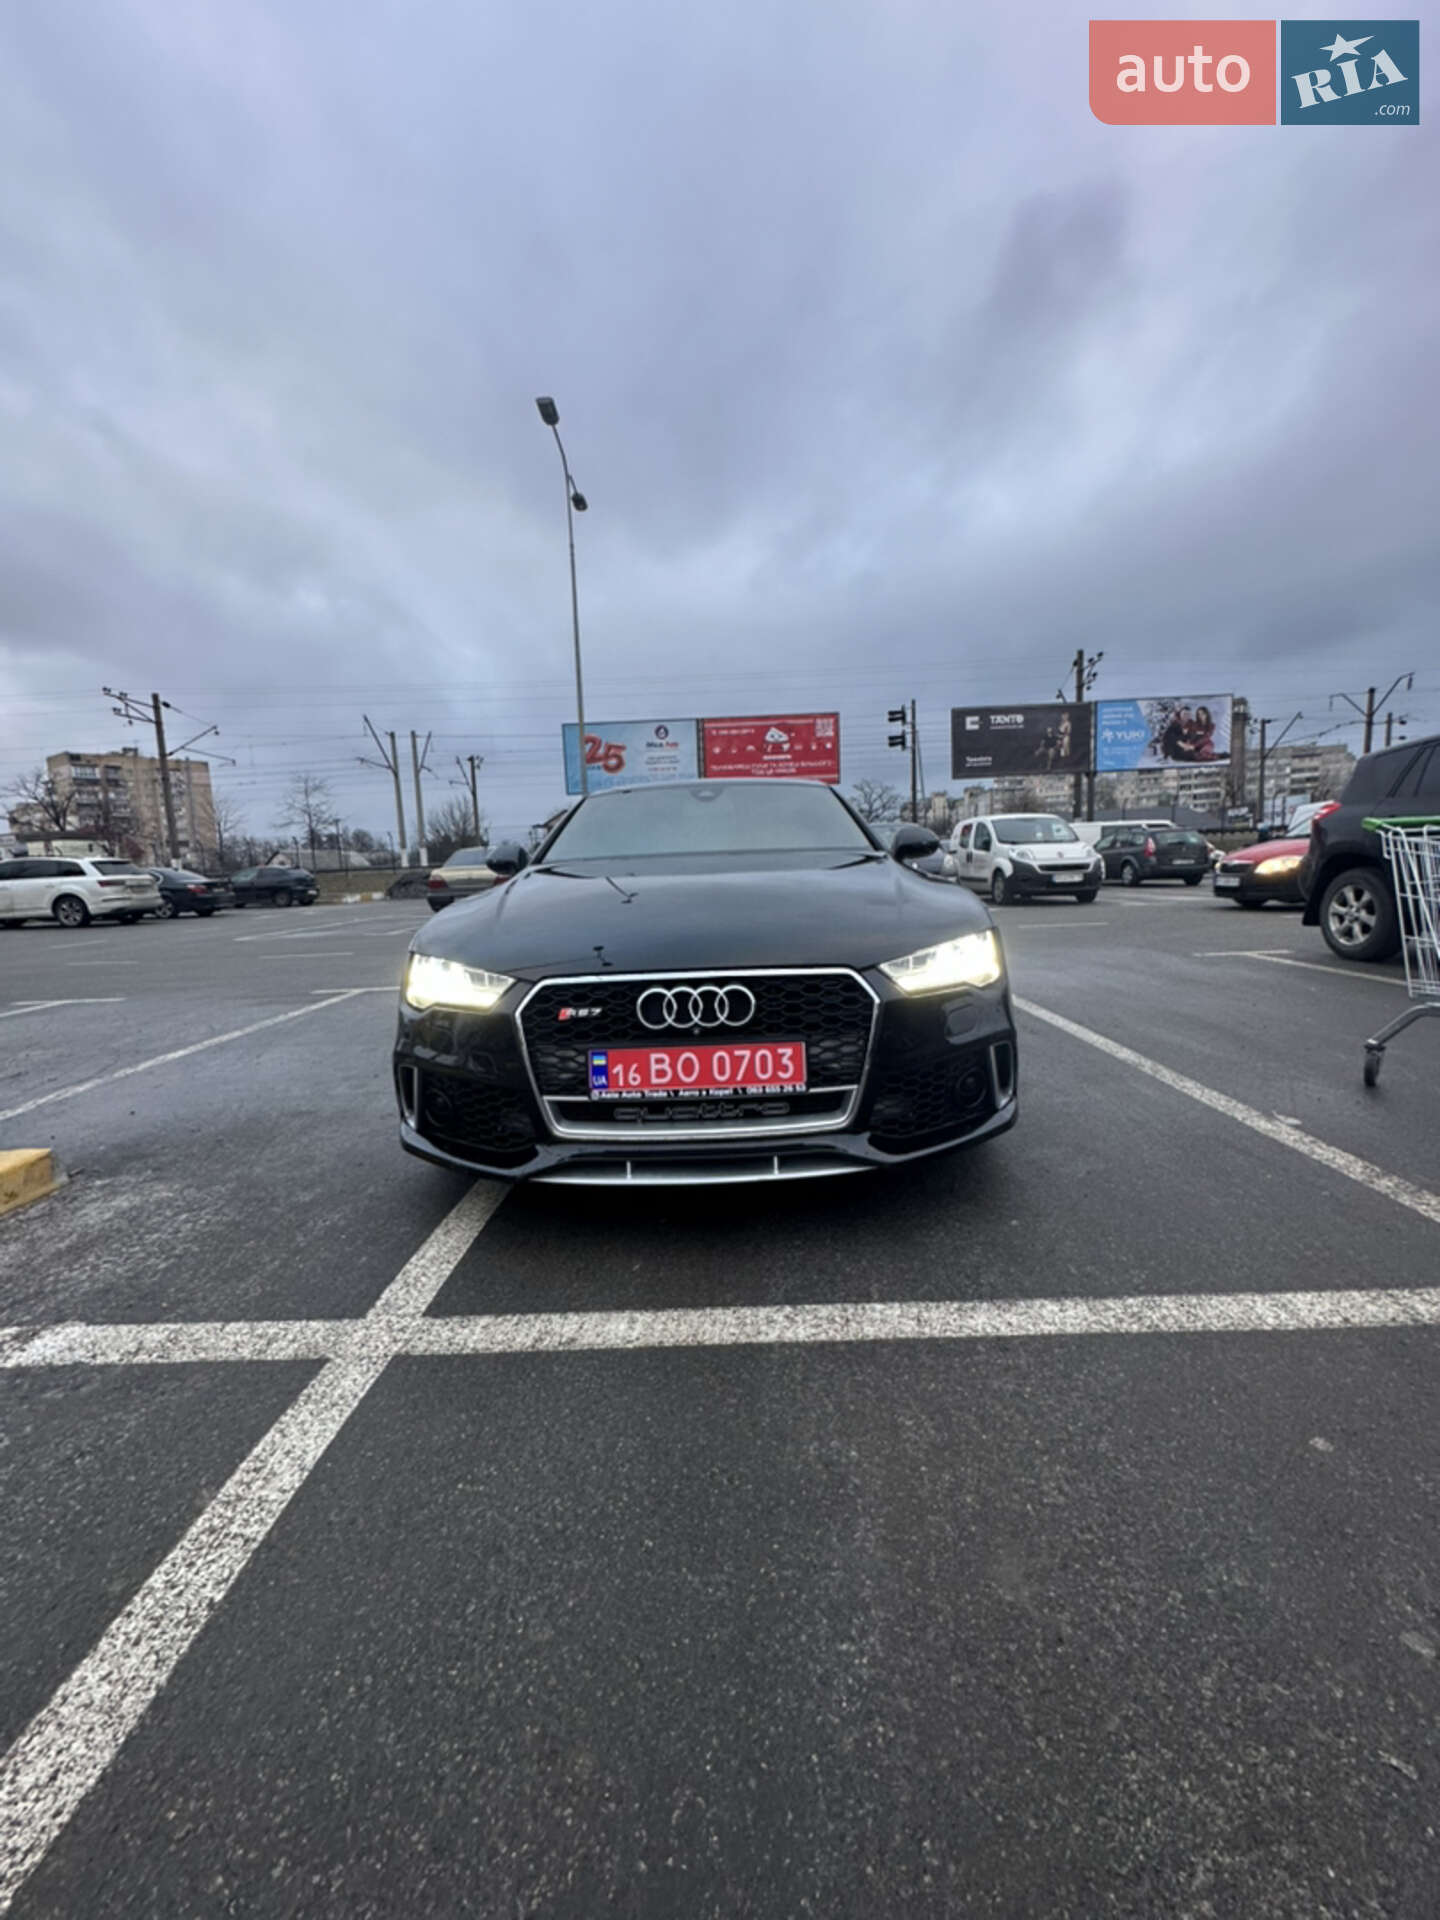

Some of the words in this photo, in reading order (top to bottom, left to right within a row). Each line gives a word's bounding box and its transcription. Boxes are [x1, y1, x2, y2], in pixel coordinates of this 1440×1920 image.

[584, 735, 627, 774] 25
[593, 1076, 607, 1087] UA
[612, 1064, 641, 1087] 16
[650, 1052, 700, 1085] BO
[712, 1047, 795, 1082] 0703
[614, 1103, 790, 1123] quattro
